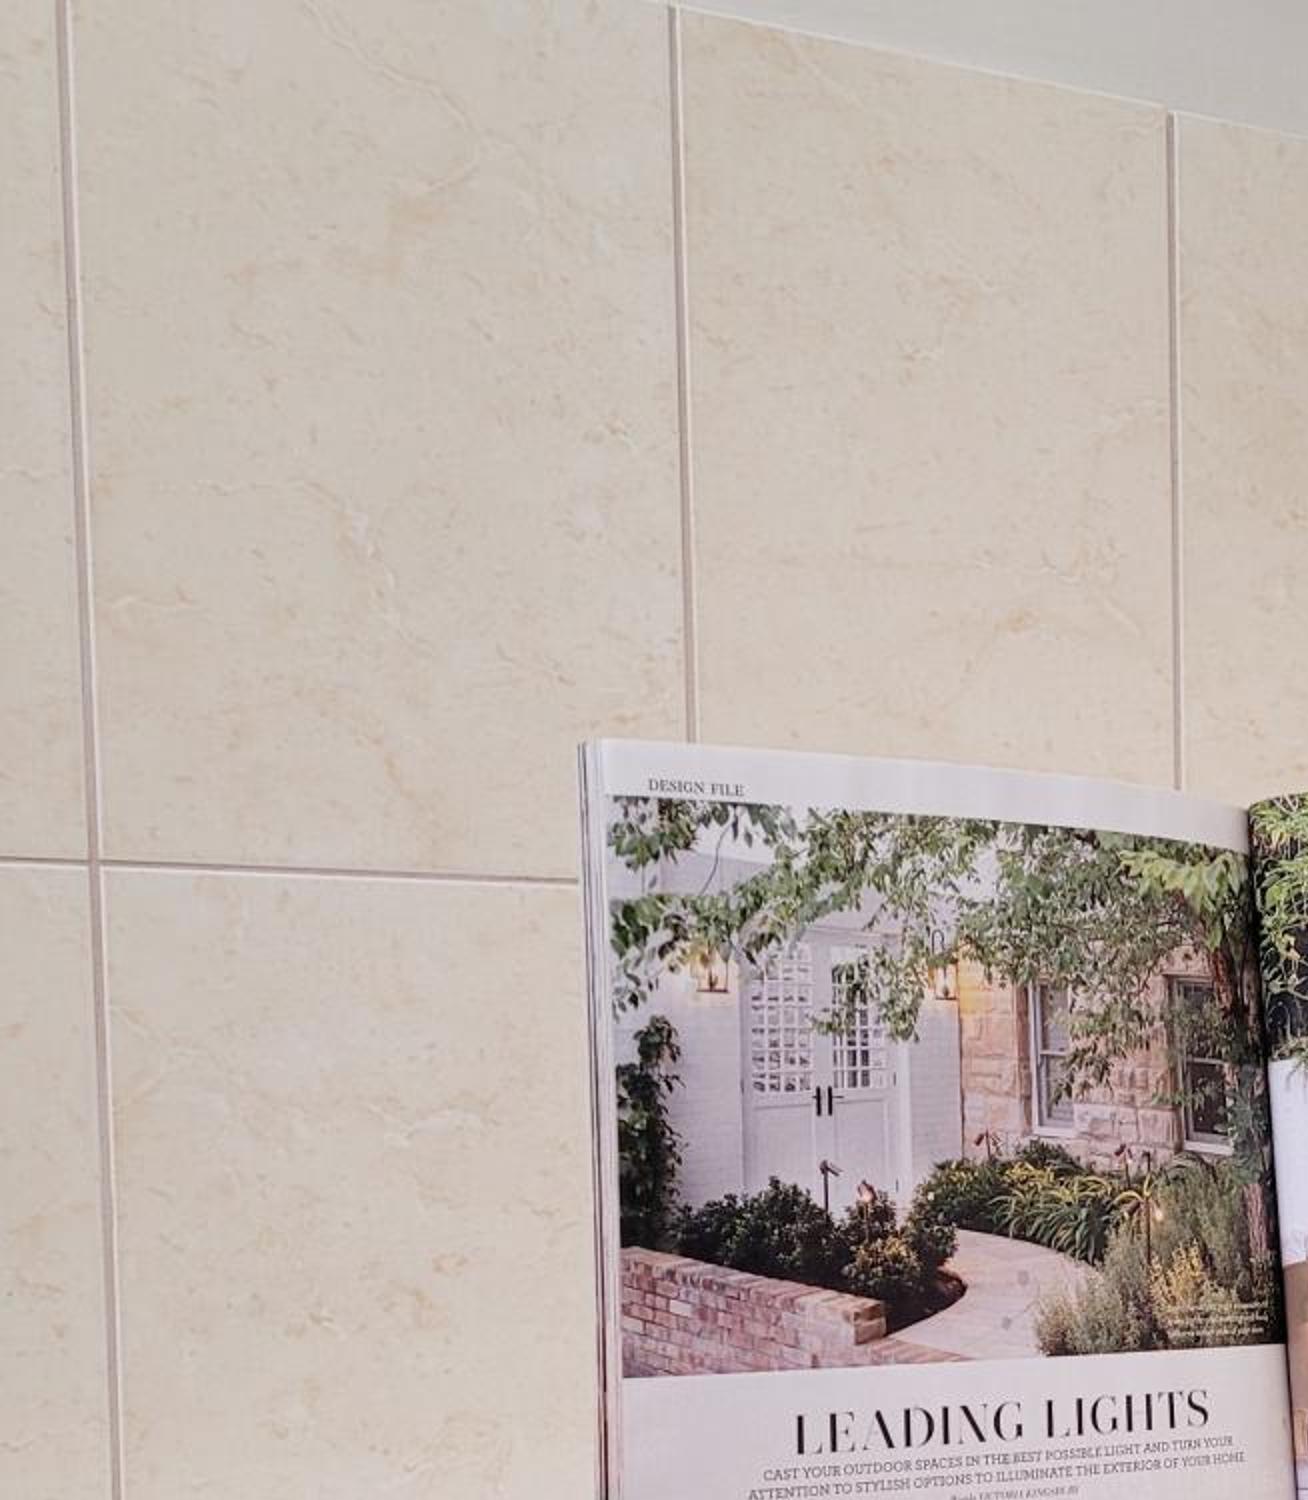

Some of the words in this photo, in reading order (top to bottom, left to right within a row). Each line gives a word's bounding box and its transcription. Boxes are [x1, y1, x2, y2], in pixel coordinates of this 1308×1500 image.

[649, 779, 704, 793] DESIGN
[711, 783, 744, 796] FILE
[797, 1401, 1023, 1455] LEADING
[1047, 1389, 1209, 1438] LIGHTS
[749, 1483, 830, 1500] ATTENTION
[833, 1482, 852, 1495] TO
[855, 1477, 910, 1493] STYLISH
[913, 1473, 972, 1489] OPTIONS
[974, 1471, 993, 1484] TO
[996, 1465, 1072, 1482] ILLUMINATE
[1076, 1463, 1100, 1476] THE
[1103, 1459, 1161, 1474] EXTERIOR
[1164, 1458, 1179, 1470] OF
[1182, 1454, 1211, 1467] YOUR
[1213, 1451, 1245, 1465] HOME
[763, 1468, 799, 1482] CAST
[802, 1465, 841, 1479] YOUR
[843, 1460, 912, 1476] OUTDOOR
[915, 1456, 962, 1471] SPACES
[965, 1455, 980, 1467] IN
[984, 1453, 1009, 1466] THE
[1013, 1451, 1041, 1464] BEST
[1045, 1447, 1102, 1461] POSSIBLE
[1104, 1443, 1140, 1457] LIGHT
[1144, 1441, 1169, 1454] AND
[1172, 1439, 1201, 1452] TURN
[1203, 1436, 1233, 1448] YOUR
